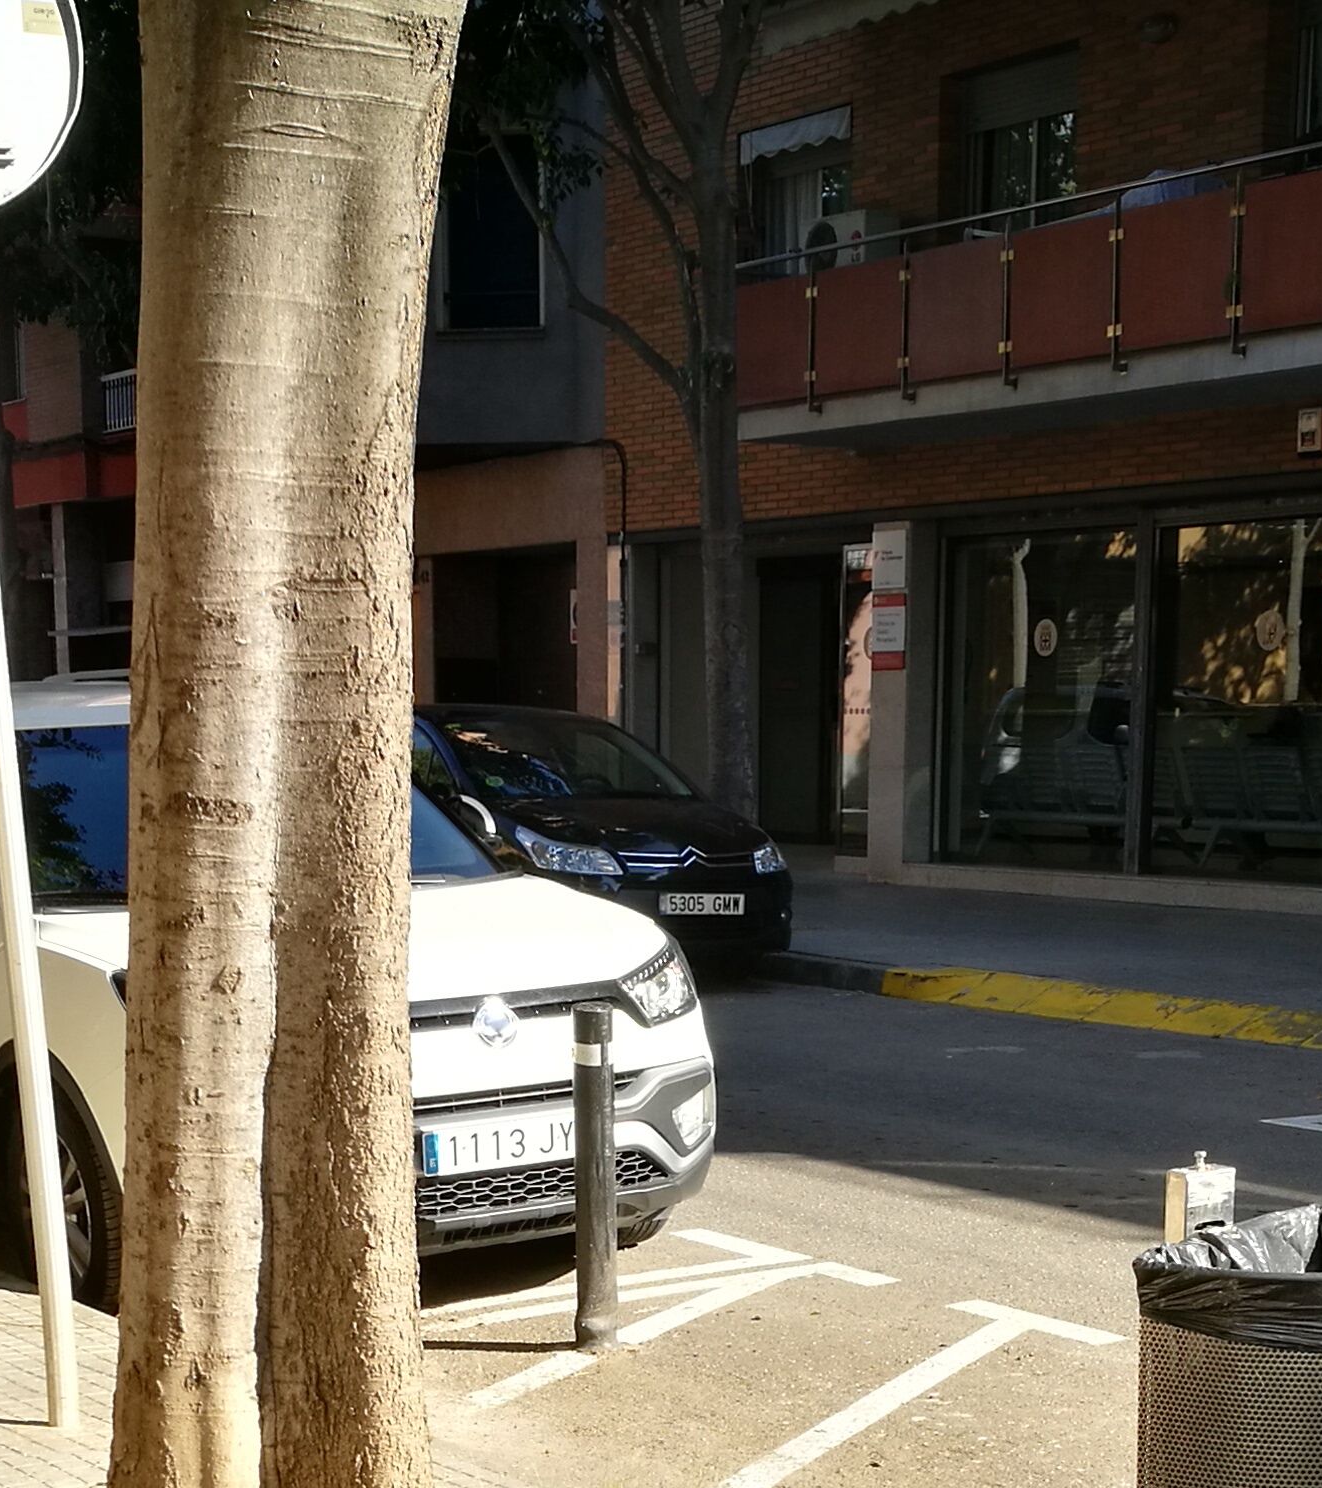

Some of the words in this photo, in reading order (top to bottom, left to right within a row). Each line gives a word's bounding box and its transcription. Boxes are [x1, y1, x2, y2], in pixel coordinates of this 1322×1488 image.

[669, 895, 705, 912] 5305
[713, 895, 741, 913] GMW
[449, 1128, 526, 1166] 1113
[539, 1121, 573, 1154] JY
